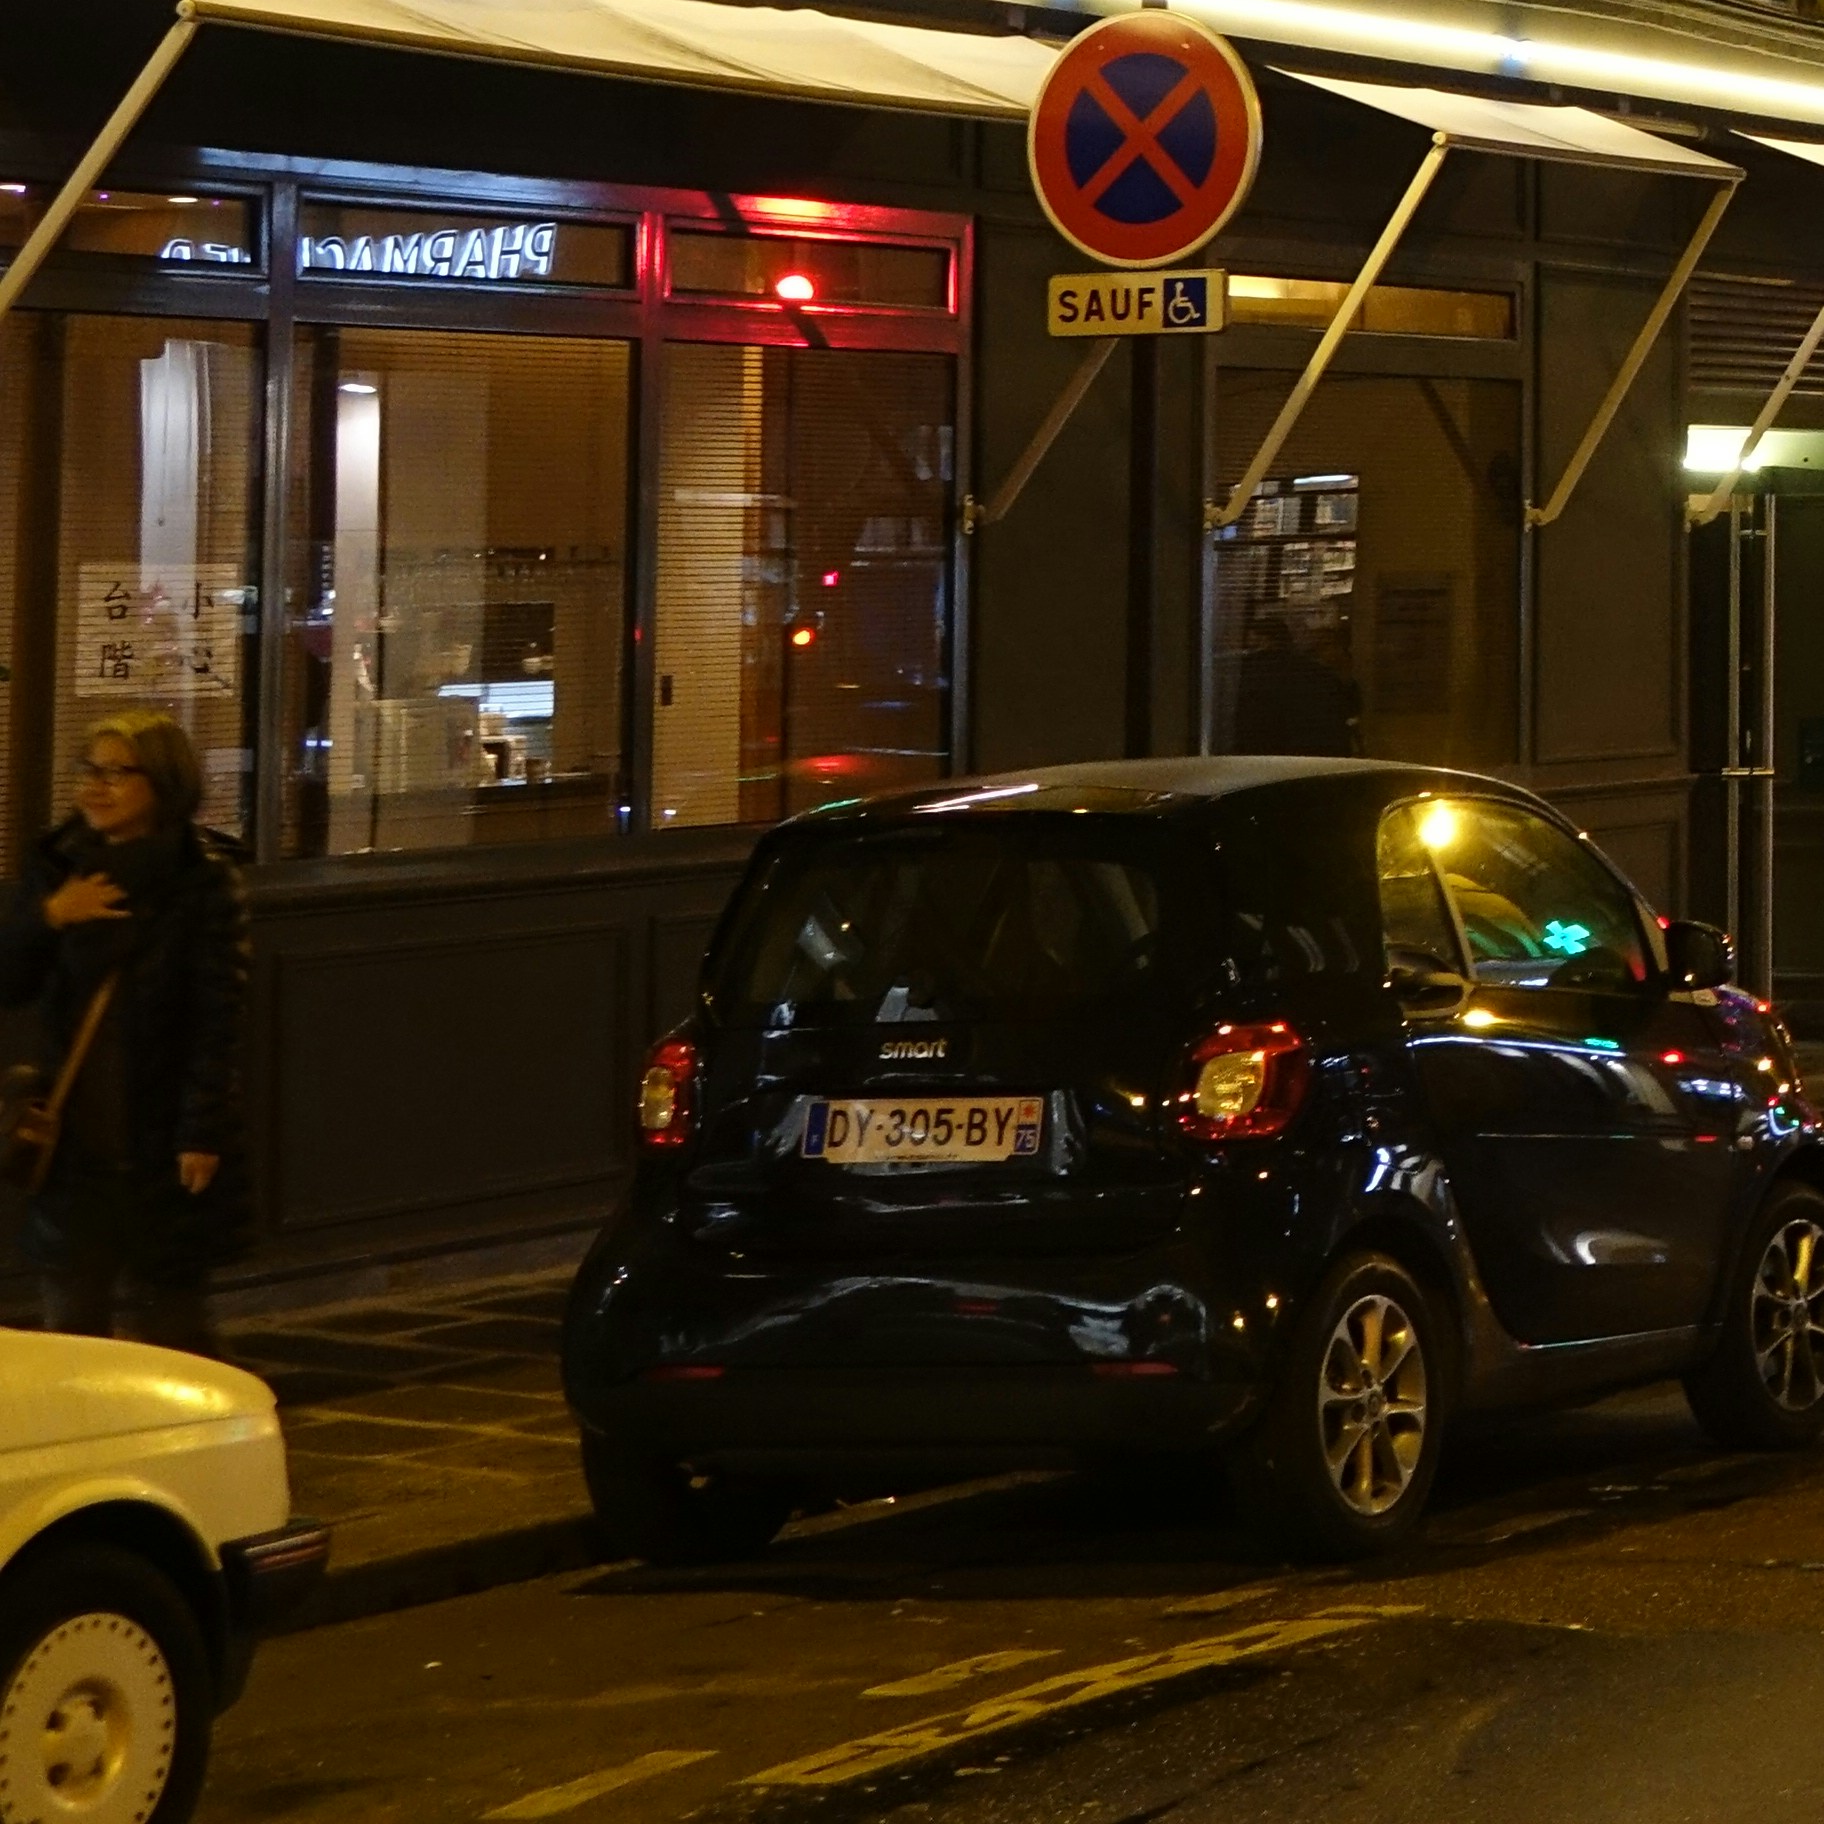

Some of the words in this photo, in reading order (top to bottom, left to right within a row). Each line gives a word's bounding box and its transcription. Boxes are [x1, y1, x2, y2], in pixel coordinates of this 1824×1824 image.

[1058, 287, 1155, 323] SAUF
[879, 1037, 947, 1059] smart
[828, 1107, 1014, 1148] DY-305-BY
